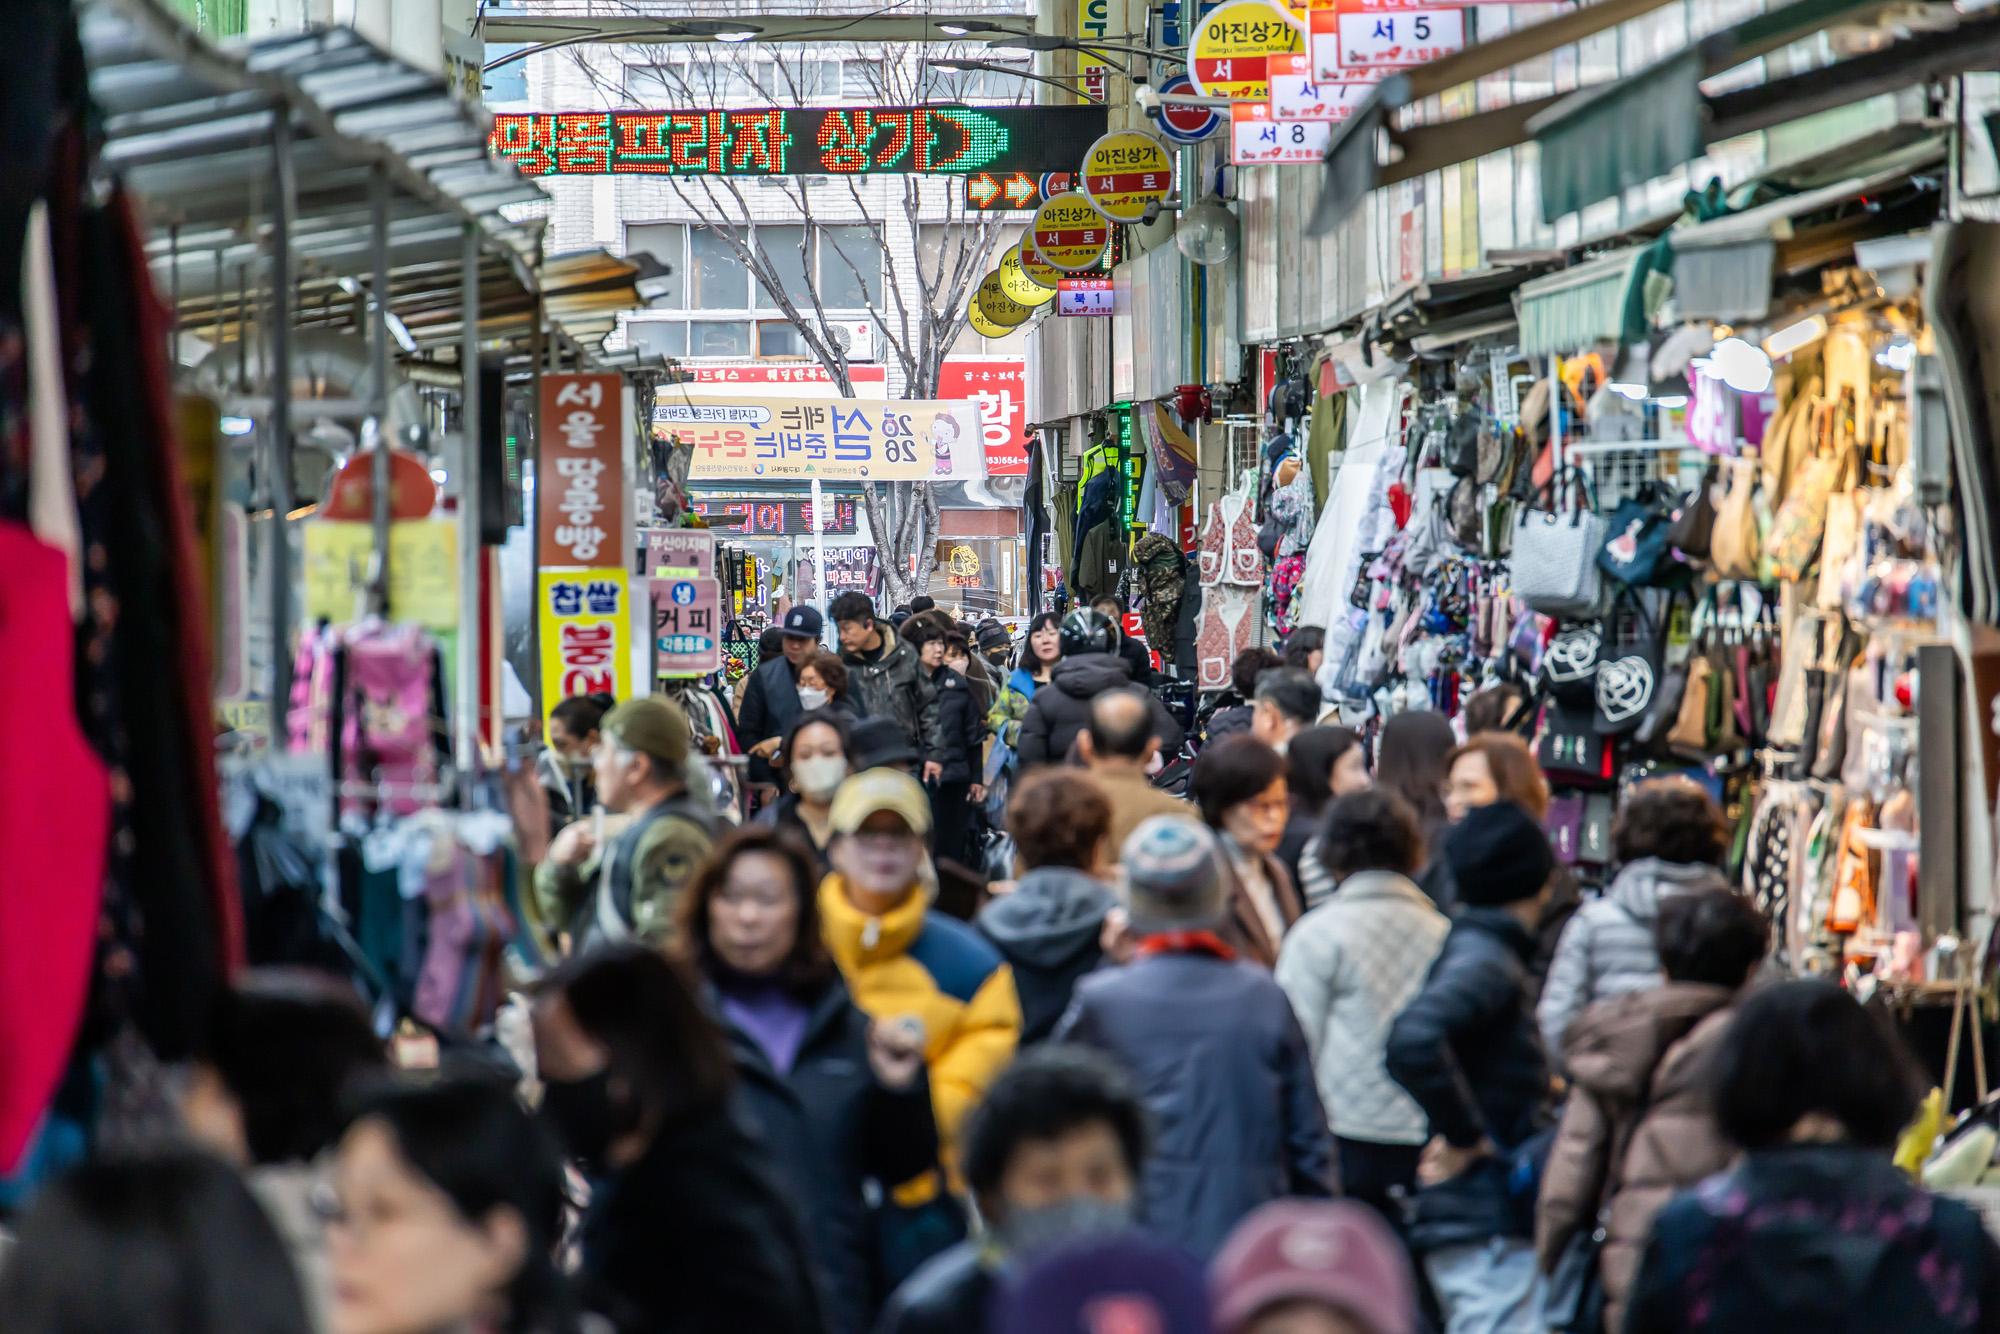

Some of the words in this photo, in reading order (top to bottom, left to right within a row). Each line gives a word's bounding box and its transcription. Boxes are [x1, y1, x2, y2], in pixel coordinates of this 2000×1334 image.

[1209, 21, 1291, 43] 아진상가
[1372, 18, 1394, 41] 서
[1414, 17, 1431, 40] 5
[1213, 59, 1232, 80] 서
[817, 110, 937, 171] 상가
[1259, 126, 1276, 143] 서
[1292, 124, 1305, 143] 8
[1096, 147, 1158, 165] 아진상가
[1100, 176, 1114, 192] 서
[1142, 174, 1157, 189] 로
[1044, 208, 1096, 222] 아진상가
[1047, 232, 1059, 245] 서
[1083, 231, 1095, 243] 로
[1071, 280, 1107, 288] 아진상가
[1095, 292, 1100, 304] 1
[556, 381, 604, 448] 서울
[555, 457, 607, 561] 땅콩빵
[552, 583, 619, 614] 찹쌀
[688, 608, 711, 633] 피
